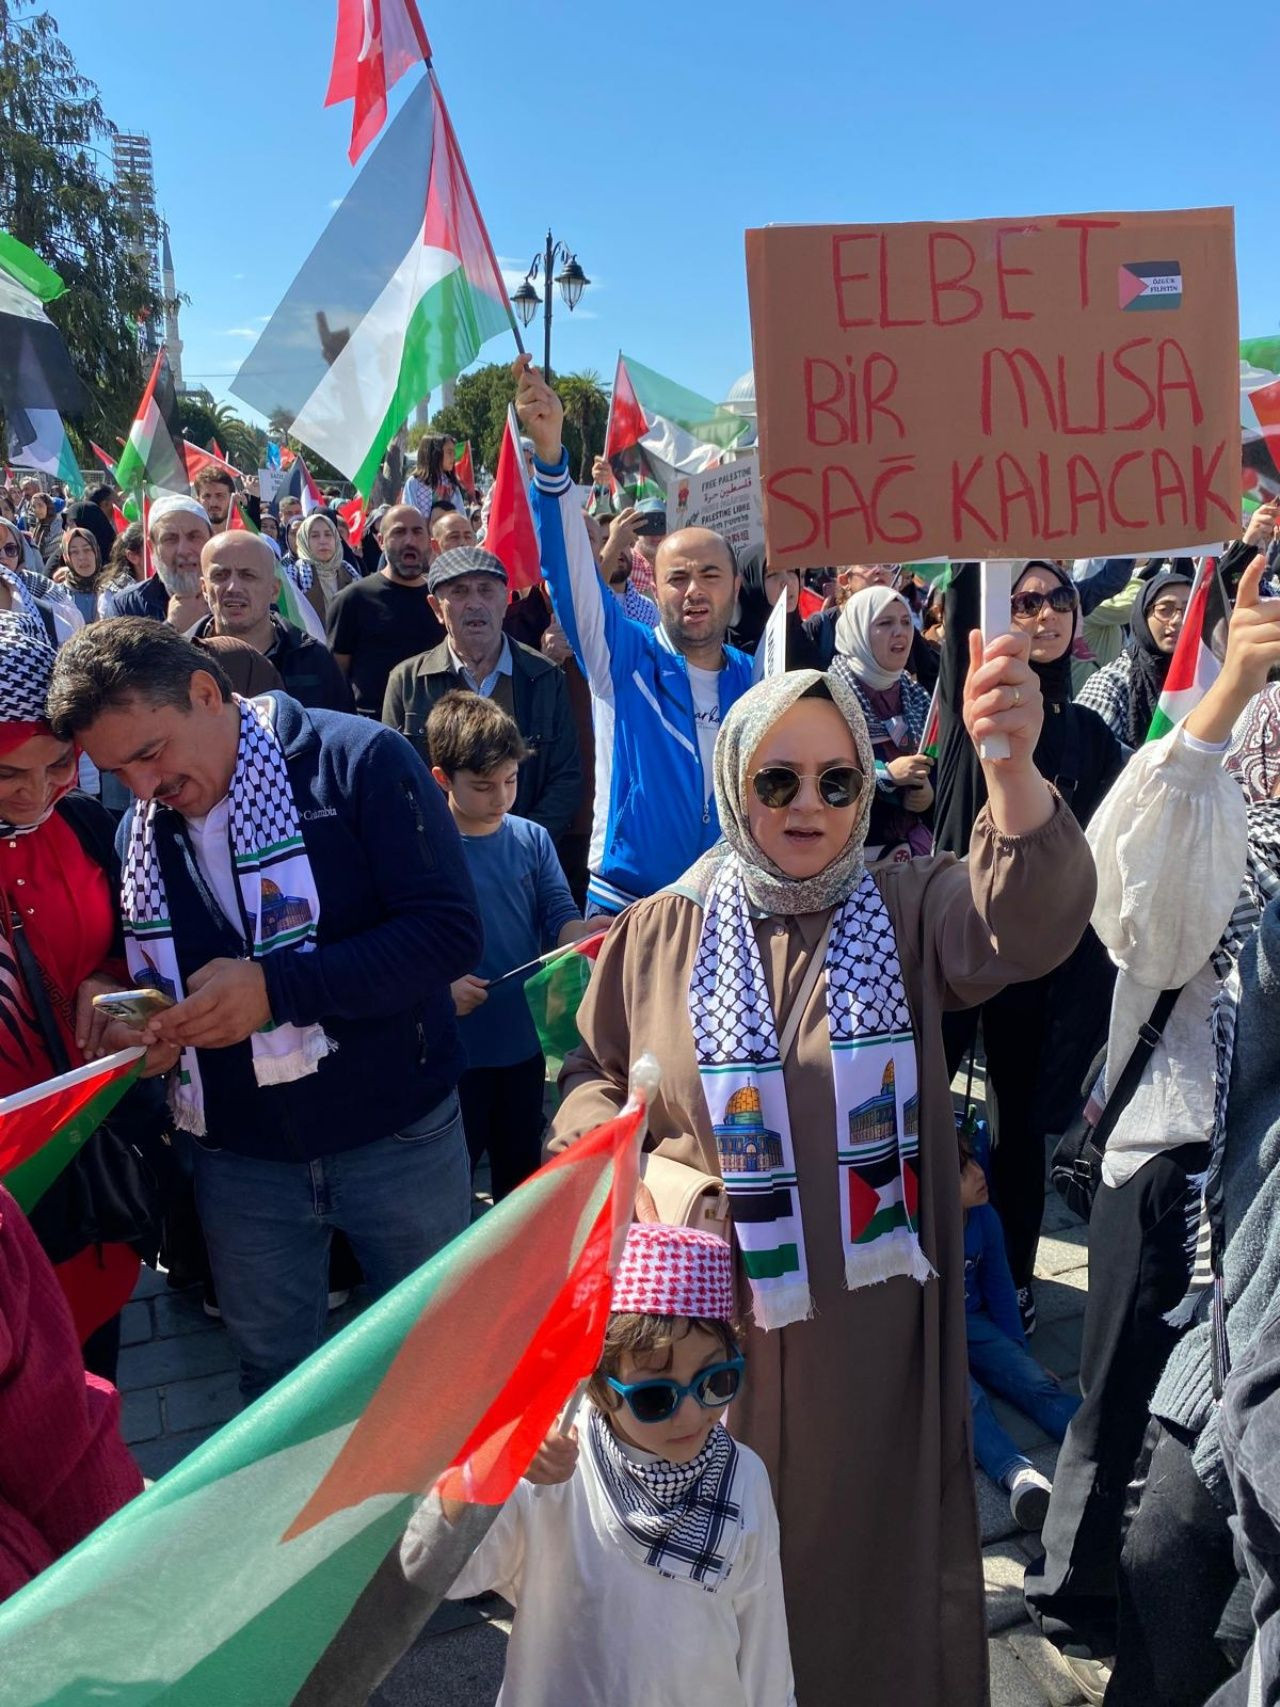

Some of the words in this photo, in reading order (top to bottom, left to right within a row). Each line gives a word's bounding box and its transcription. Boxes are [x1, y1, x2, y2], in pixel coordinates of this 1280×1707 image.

[832, 219, 1120, 330] ELBET
[980, 337, 1204, 437] MUSA
[702, 478, 717, 492] FREE
[951, 440, 1237, 544] KALACAK
